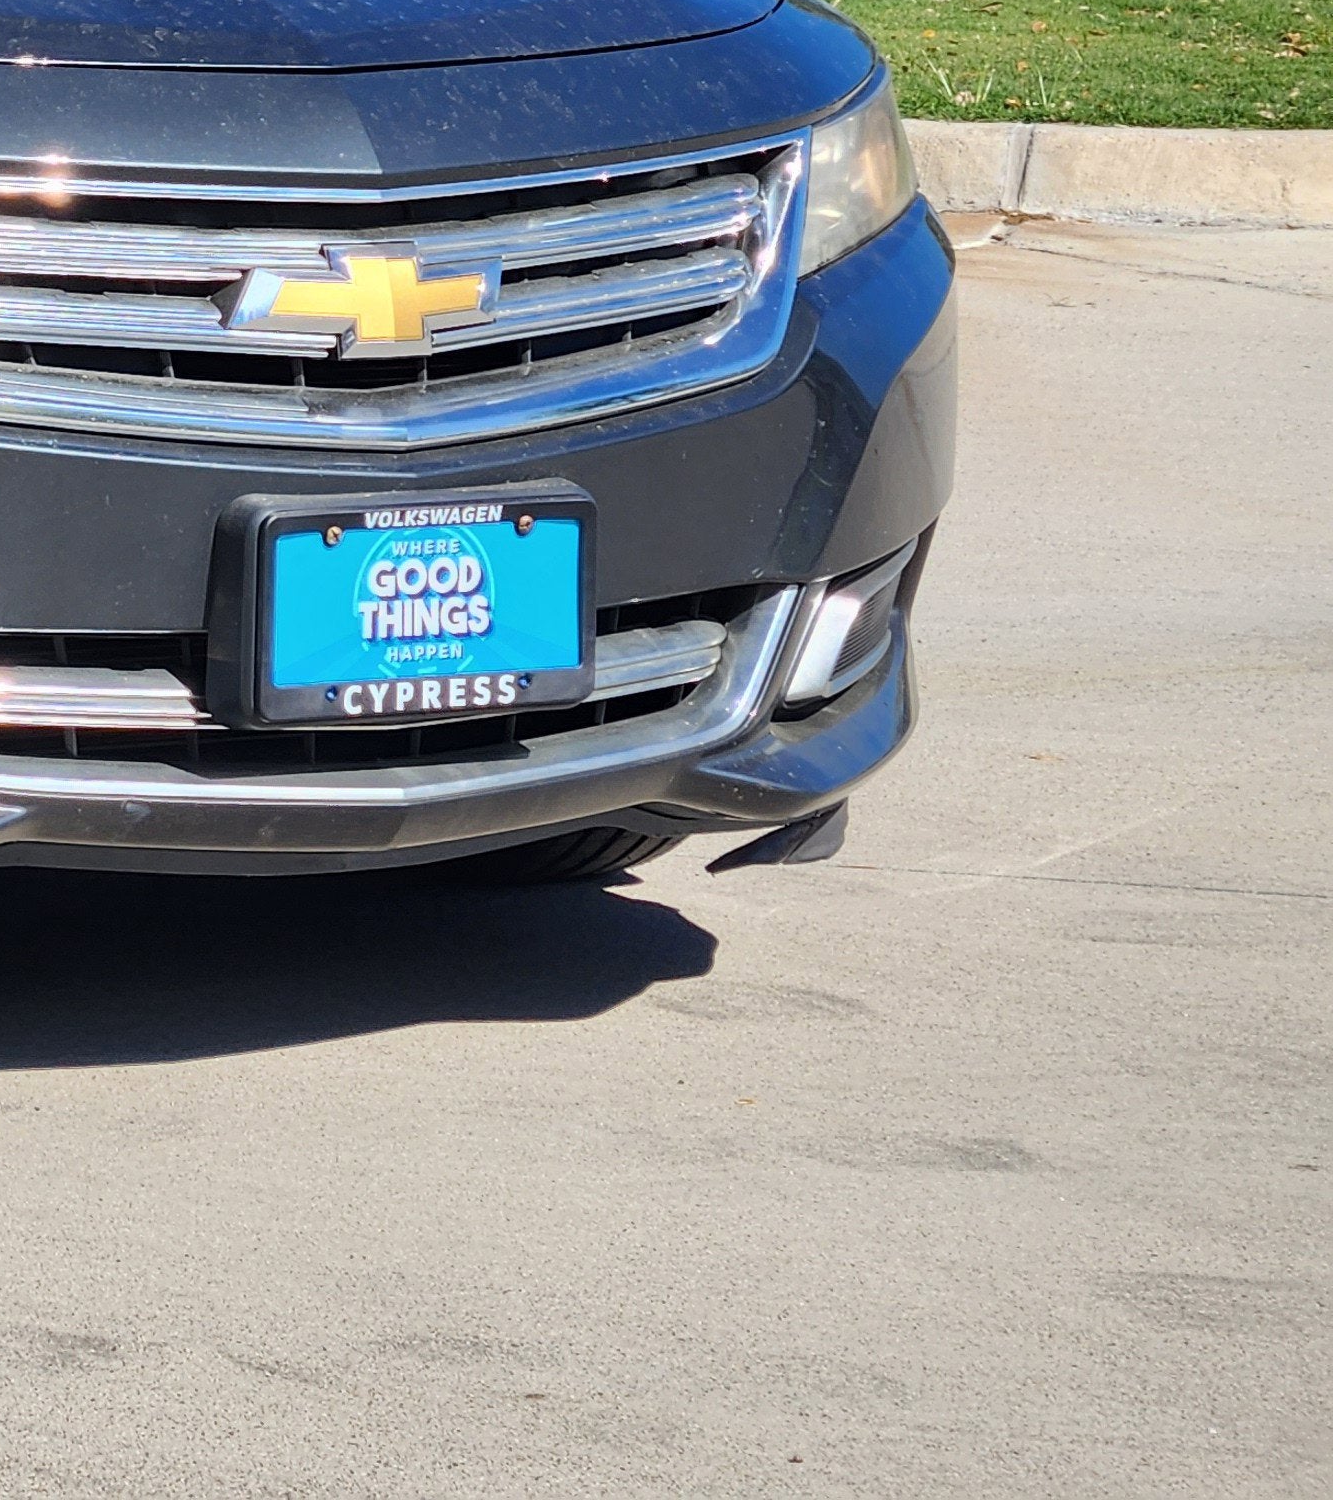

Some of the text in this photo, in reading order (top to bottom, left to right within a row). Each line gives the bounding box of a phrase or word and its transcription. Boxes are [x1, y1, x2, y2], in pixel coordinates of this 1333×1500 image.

[364, 505, 504, 529] VOLKSWAGEN
[391, 538, 461, 557] WHERE
[367, 556, 484, 598] GOOD
[358, 595, 492, 641] THINGS
[387, 643, 465, 663] HAPPEN
[343, 674, 517, 716] CYPRESS
